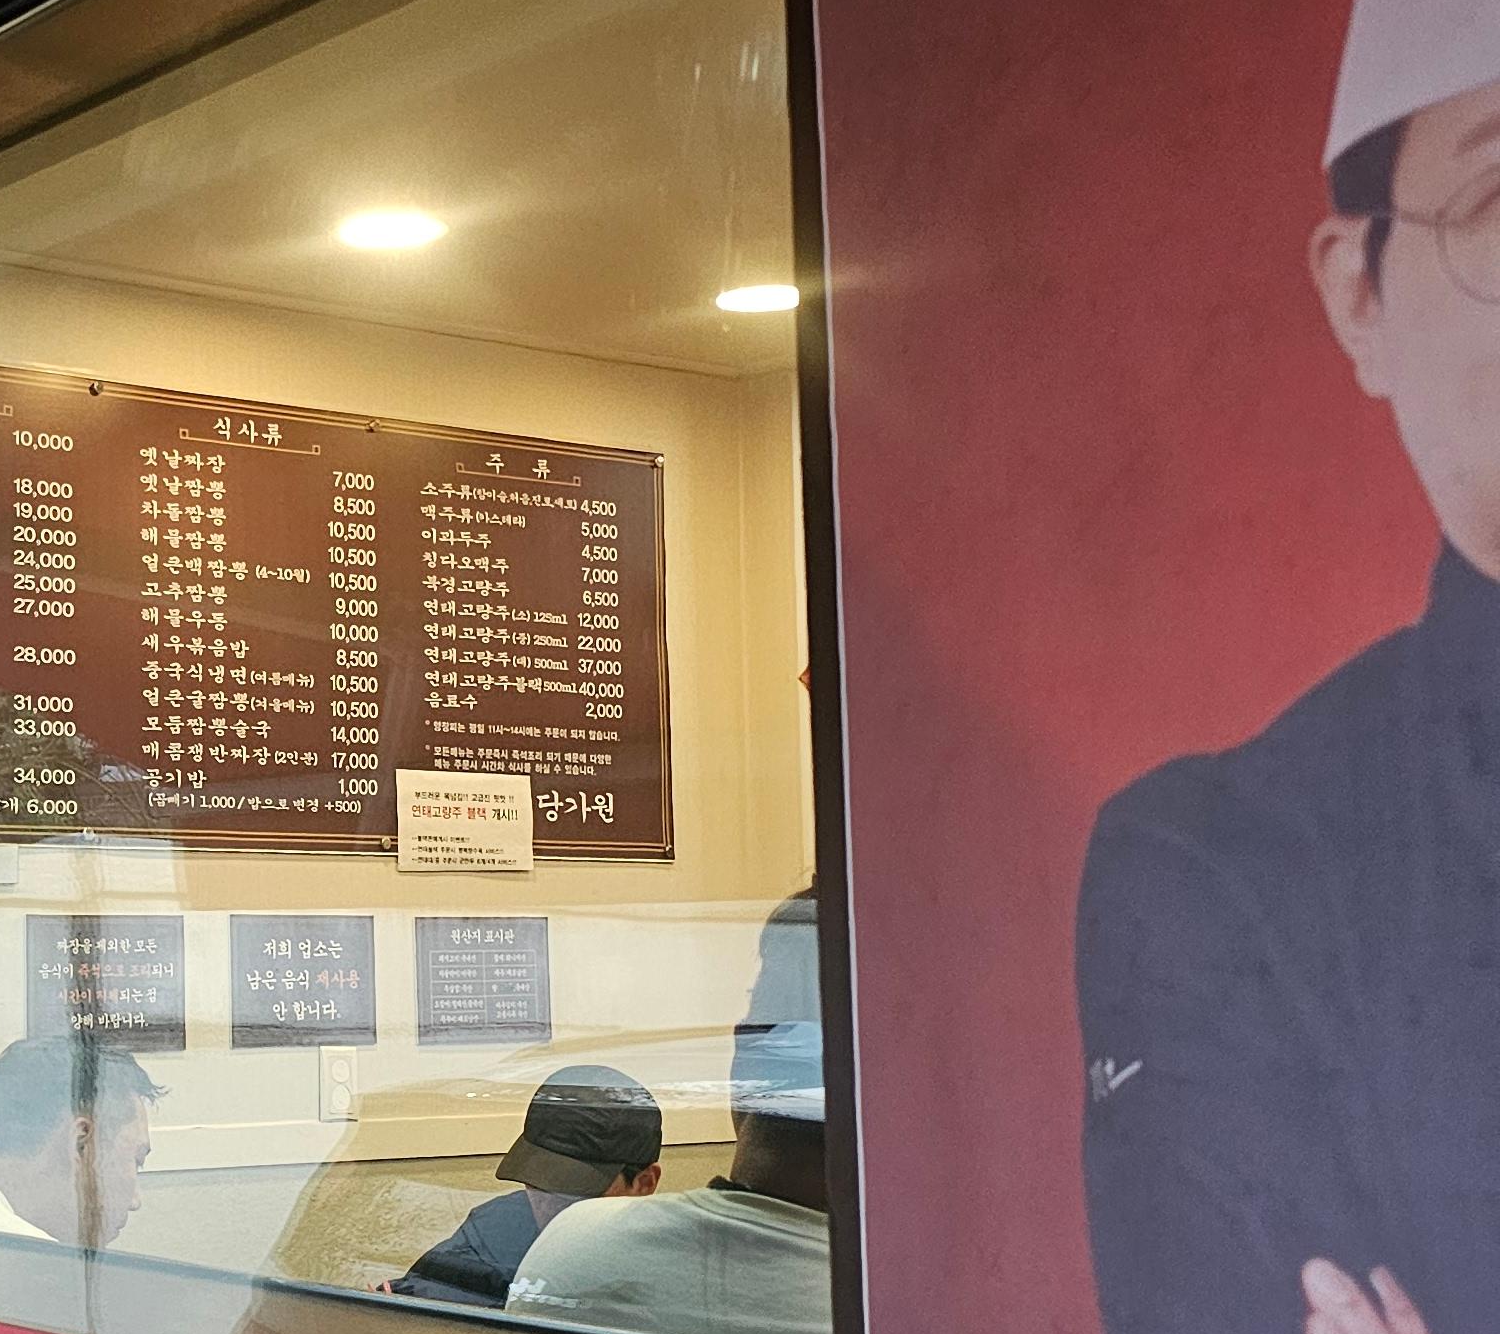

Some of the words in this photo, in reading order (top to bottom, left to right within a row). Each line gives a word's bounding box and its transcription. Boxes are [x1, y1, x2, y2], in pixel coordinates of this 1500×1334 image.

[12, 430, 73, 452] 10,000
[213, 417, 282, 446] 식사류
[140, 447, 225, 474] 옛날짜장
[333, 471, 374, 491] 7,000
[13, 478, 73, 499] 18,000
[140, 474, 226, 500] 옛날짬뽕
[334, 496, 375, 516] 8,500
[13, 502, 73, 523] 19,000
[581, 500, 617, 517] 4,500
[141, 500, 226, 527] 차돌짬뽕
[328, 521, 376, 541] 10,500
[421, 504, 473, 524] 맥주류
[582, 521, 617, 540] 5,000
[13, 526, 76, 547] 20,000
[141, 527, 227, 552] 해물짬뽕
[328, 547, 376, 567] 10,500
[421, 528, 491, 549] 이과두주
[582, 545, 617, 562] 4,500
[13, 550, 76, 570] 24,000
[422, 551, 509, 574] 칭다오맥주
[582, 567, 618, 584] 7,000
[141, 553, 248, 580] 얼큰백짬뽕
[329, 572, 377, 592] 10,500
[13, 574, 76, 594] 25,000
[422, 575, 509, 597] 북경고량주
[583, 591, 619, 607] 6,500
[13, 598, 75, 618] 27,000
[141, 583, 227, 604] 고추짬뽕
[335, 598, 378, 618] 9,000
[141, 607, 228, 631] 해물우동
[330, 623, 378, 643] 10,000
[578, 613, 619, 630] 12,000
[141, 633, 249, 658] 새우볶음밥
[336, 649, 377, 668] 8,500
[578, 636, 621, 653] 22,000
[13, 646, 76, 666] 28,000
[578, 659, 621, 676] 37,000
[330, 674, 378, 694] 10,500
[579, 682, 624, 699] 40,000
[13, 695, 73, 714] 31,000
[330, 701, 378, 719] 10,500
[424, 693, 477, 710] 음료수
[585, 704, 623, 719] 2,000
[13, 719, 76, 739] 33,000
[330, 727, 379, 745] 14,000
[141, 741, 271, 765] 매콤쟁반짜장
[274, 751, 318, 766] (2인분)
[331, 752, 379, 771] 17,000
[13, 768, 76, 787] 34,000
[142, 769, 207, 788] 공기밥
[338, 779, 378, 797] 1,000
[248, 797, 289, 811] 밥으로
[292, 798, 319, 812] 변경
[325, 800, 362, 814] +500)
[536, 790, 614, 823] 당가원
[134, 939, 157, 953] 모든
[263, 939, 292, 959] 저희
[299, 939, 343, 959] 업소는
[39, 963, 73, 979] 음식이
[246, 971, 276, 991] 남은
[282, 970, 310, 991] 음식
[316, 970, 360, 989] 재사용
[273, 1001, 287, 1020] 안
[294, 999, 341, 1020] 합니다.
[98, 1013, 148, 1028] 바랍니다.
